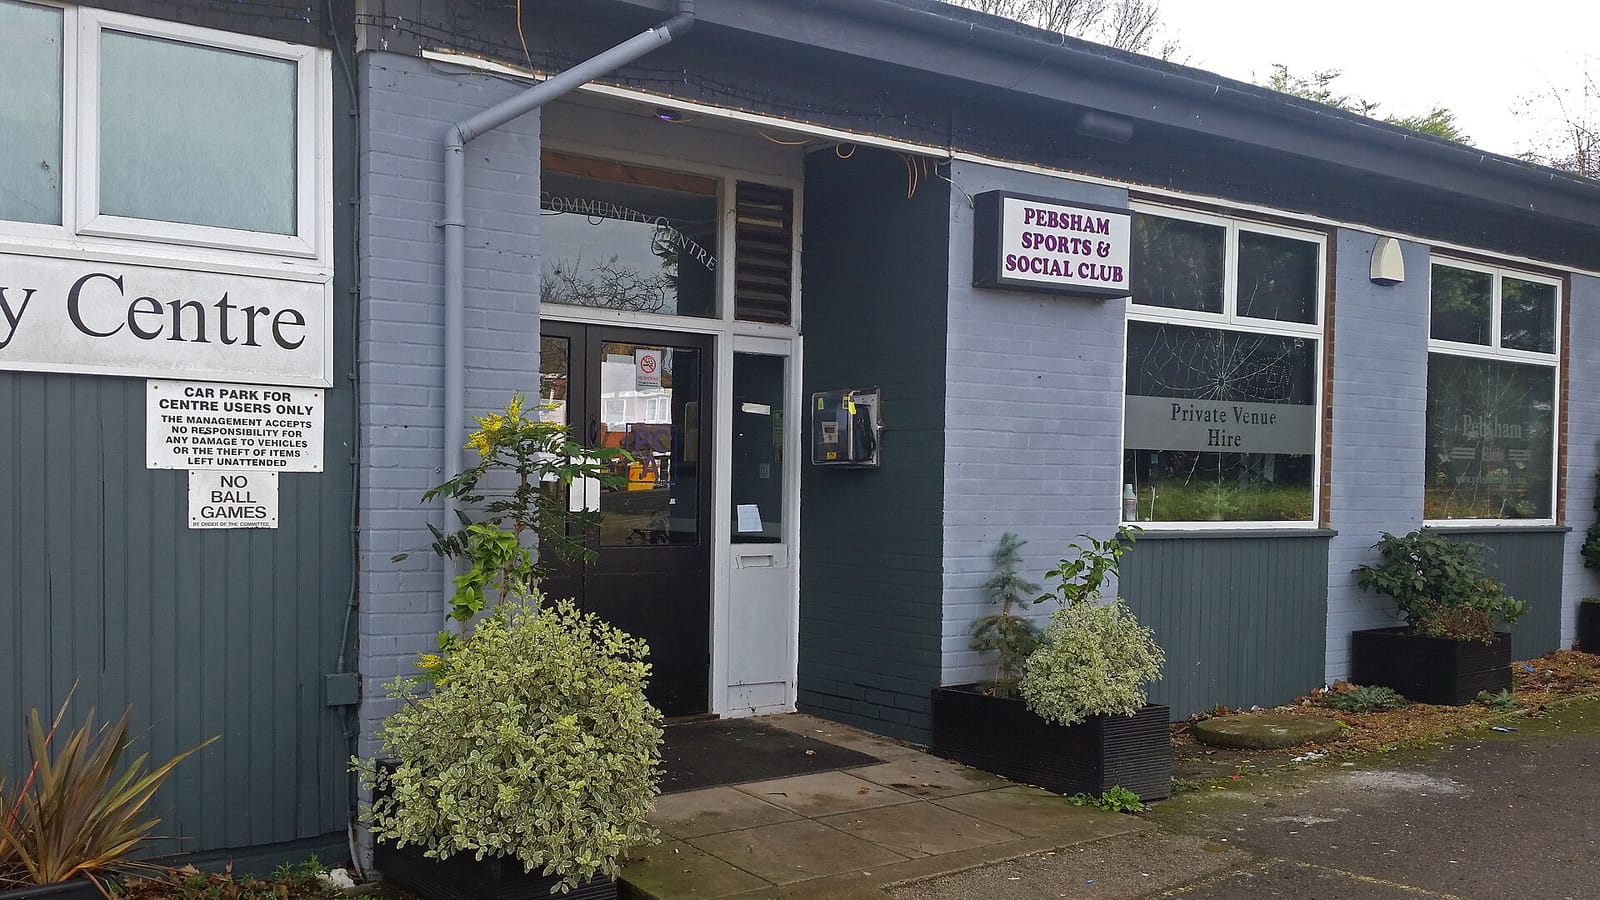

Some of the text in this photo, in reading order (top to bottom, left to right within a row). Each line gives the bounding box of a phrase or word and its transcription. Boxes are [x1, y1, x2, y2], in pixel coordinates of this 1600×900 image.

[1024, 207, 1110, 235] PEBSHAM
[1022, 232, 1111, 258] SPORTS &
[1006, 254, 1124, 283] SOCIAL CLUB
[67, 273, 306, 350] Centre
[185, 387, 291, 402] CAR PARK FOR
[159, 399, 313, 416] CENTRE USERS ONLY
[1171, 402, 1276, 425] Private Venue
[161, 415, 312, 429] THE MANAGEMENT ACCEPTS
[171, 426, 302, 438] NO RESPONSIBILITY FOR
[1207, 428, 1242, 447] Hire
[166, 436, 308, 448] ANY DAMAGE TO VEHICLES
[173, 446, 301, 458] OR THE THEFT OF ITEMS
[187, 457, 287, 467] LEFT UNATTENDED
[220, 475, 248, 488] NO
[211, 491, 257, 503] BALL
[200, 506, 267, 518] GAMES
